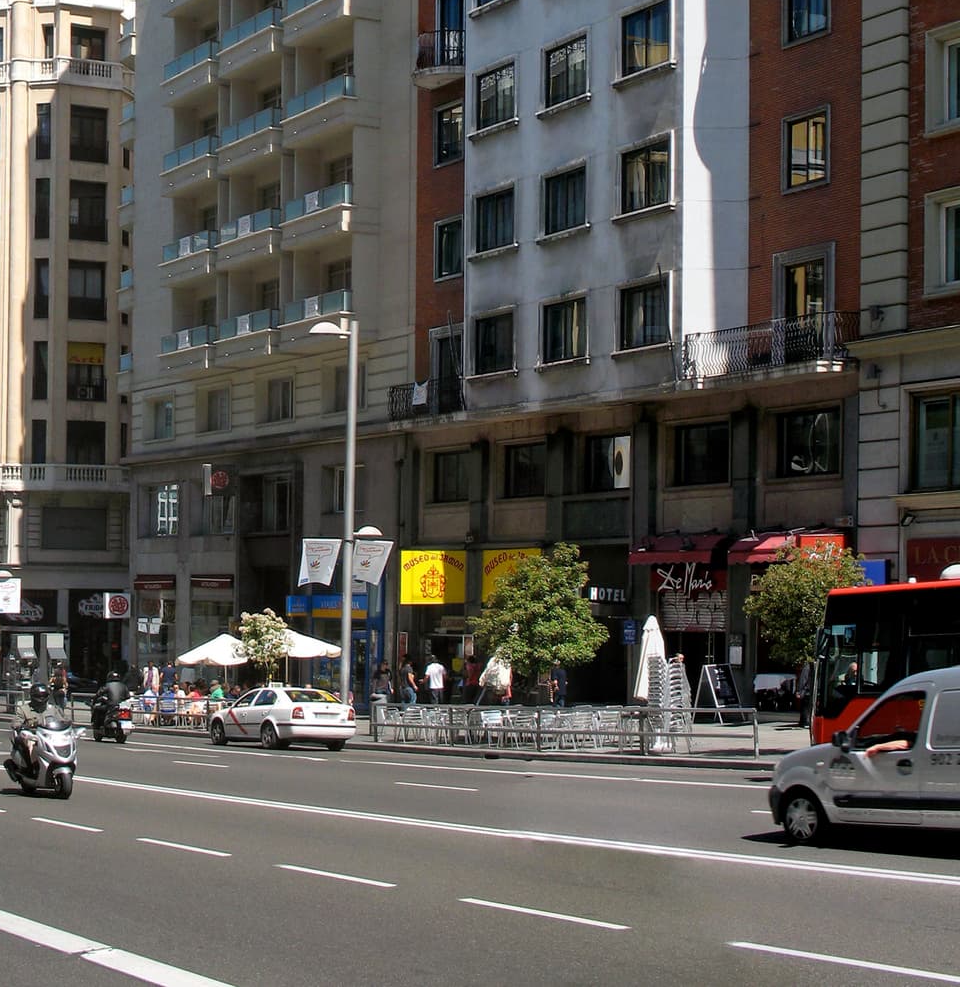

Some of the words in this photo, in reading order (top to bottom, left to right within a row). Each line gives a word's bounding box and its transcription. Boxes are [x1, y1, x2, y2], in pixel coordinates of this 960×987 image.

[403, 554, 429, 572] MUSEO
[484, 552, 507, 576] MUSEO
[915, 546, 940, 564] LA
[590, 587, 626, 602] HOTEL
